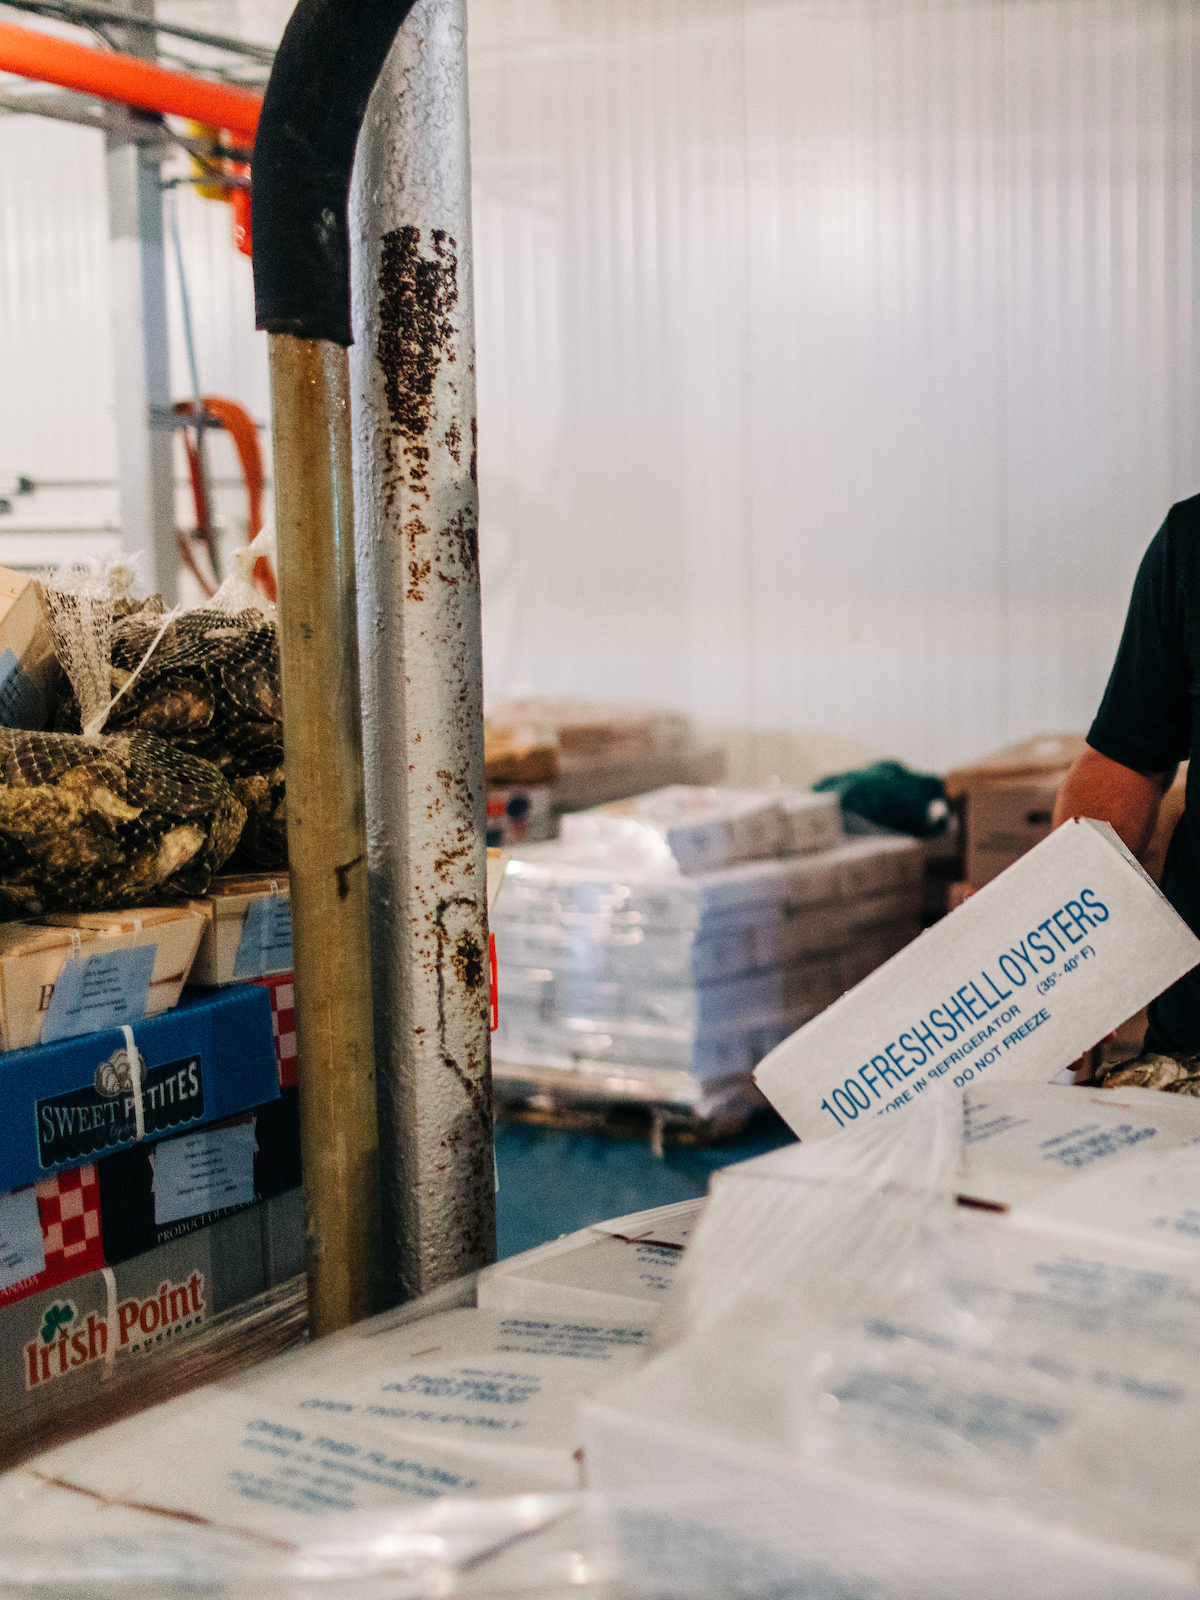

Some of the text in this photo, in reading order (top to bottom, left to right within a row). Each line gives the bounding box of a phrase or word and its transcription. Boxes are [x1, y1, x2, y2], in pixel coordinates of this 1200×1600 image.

[820, 1078, 872, 1128] 100
[857, 1019, 944, 1099] FRESH
[928, 970, 1013, 1043] SHELL
[998, 888, 1111, 987] OYSTERS
[952, 1007, 1052, 1088] DO NOT FREEZE
[41, 1060, 200, 1144] SWEET PTITES
[872, 1089, 914, 1118] ORE
[912, 1076, 928, 1095] IN
[928, 1004, 1021, 1080] REFRIGERATOR
[156, 1214, 205, 1243] PRODUCT
[0, 1273, 40, 1298] ANADA
[27, 1274, 204, 1386] Irish Point
